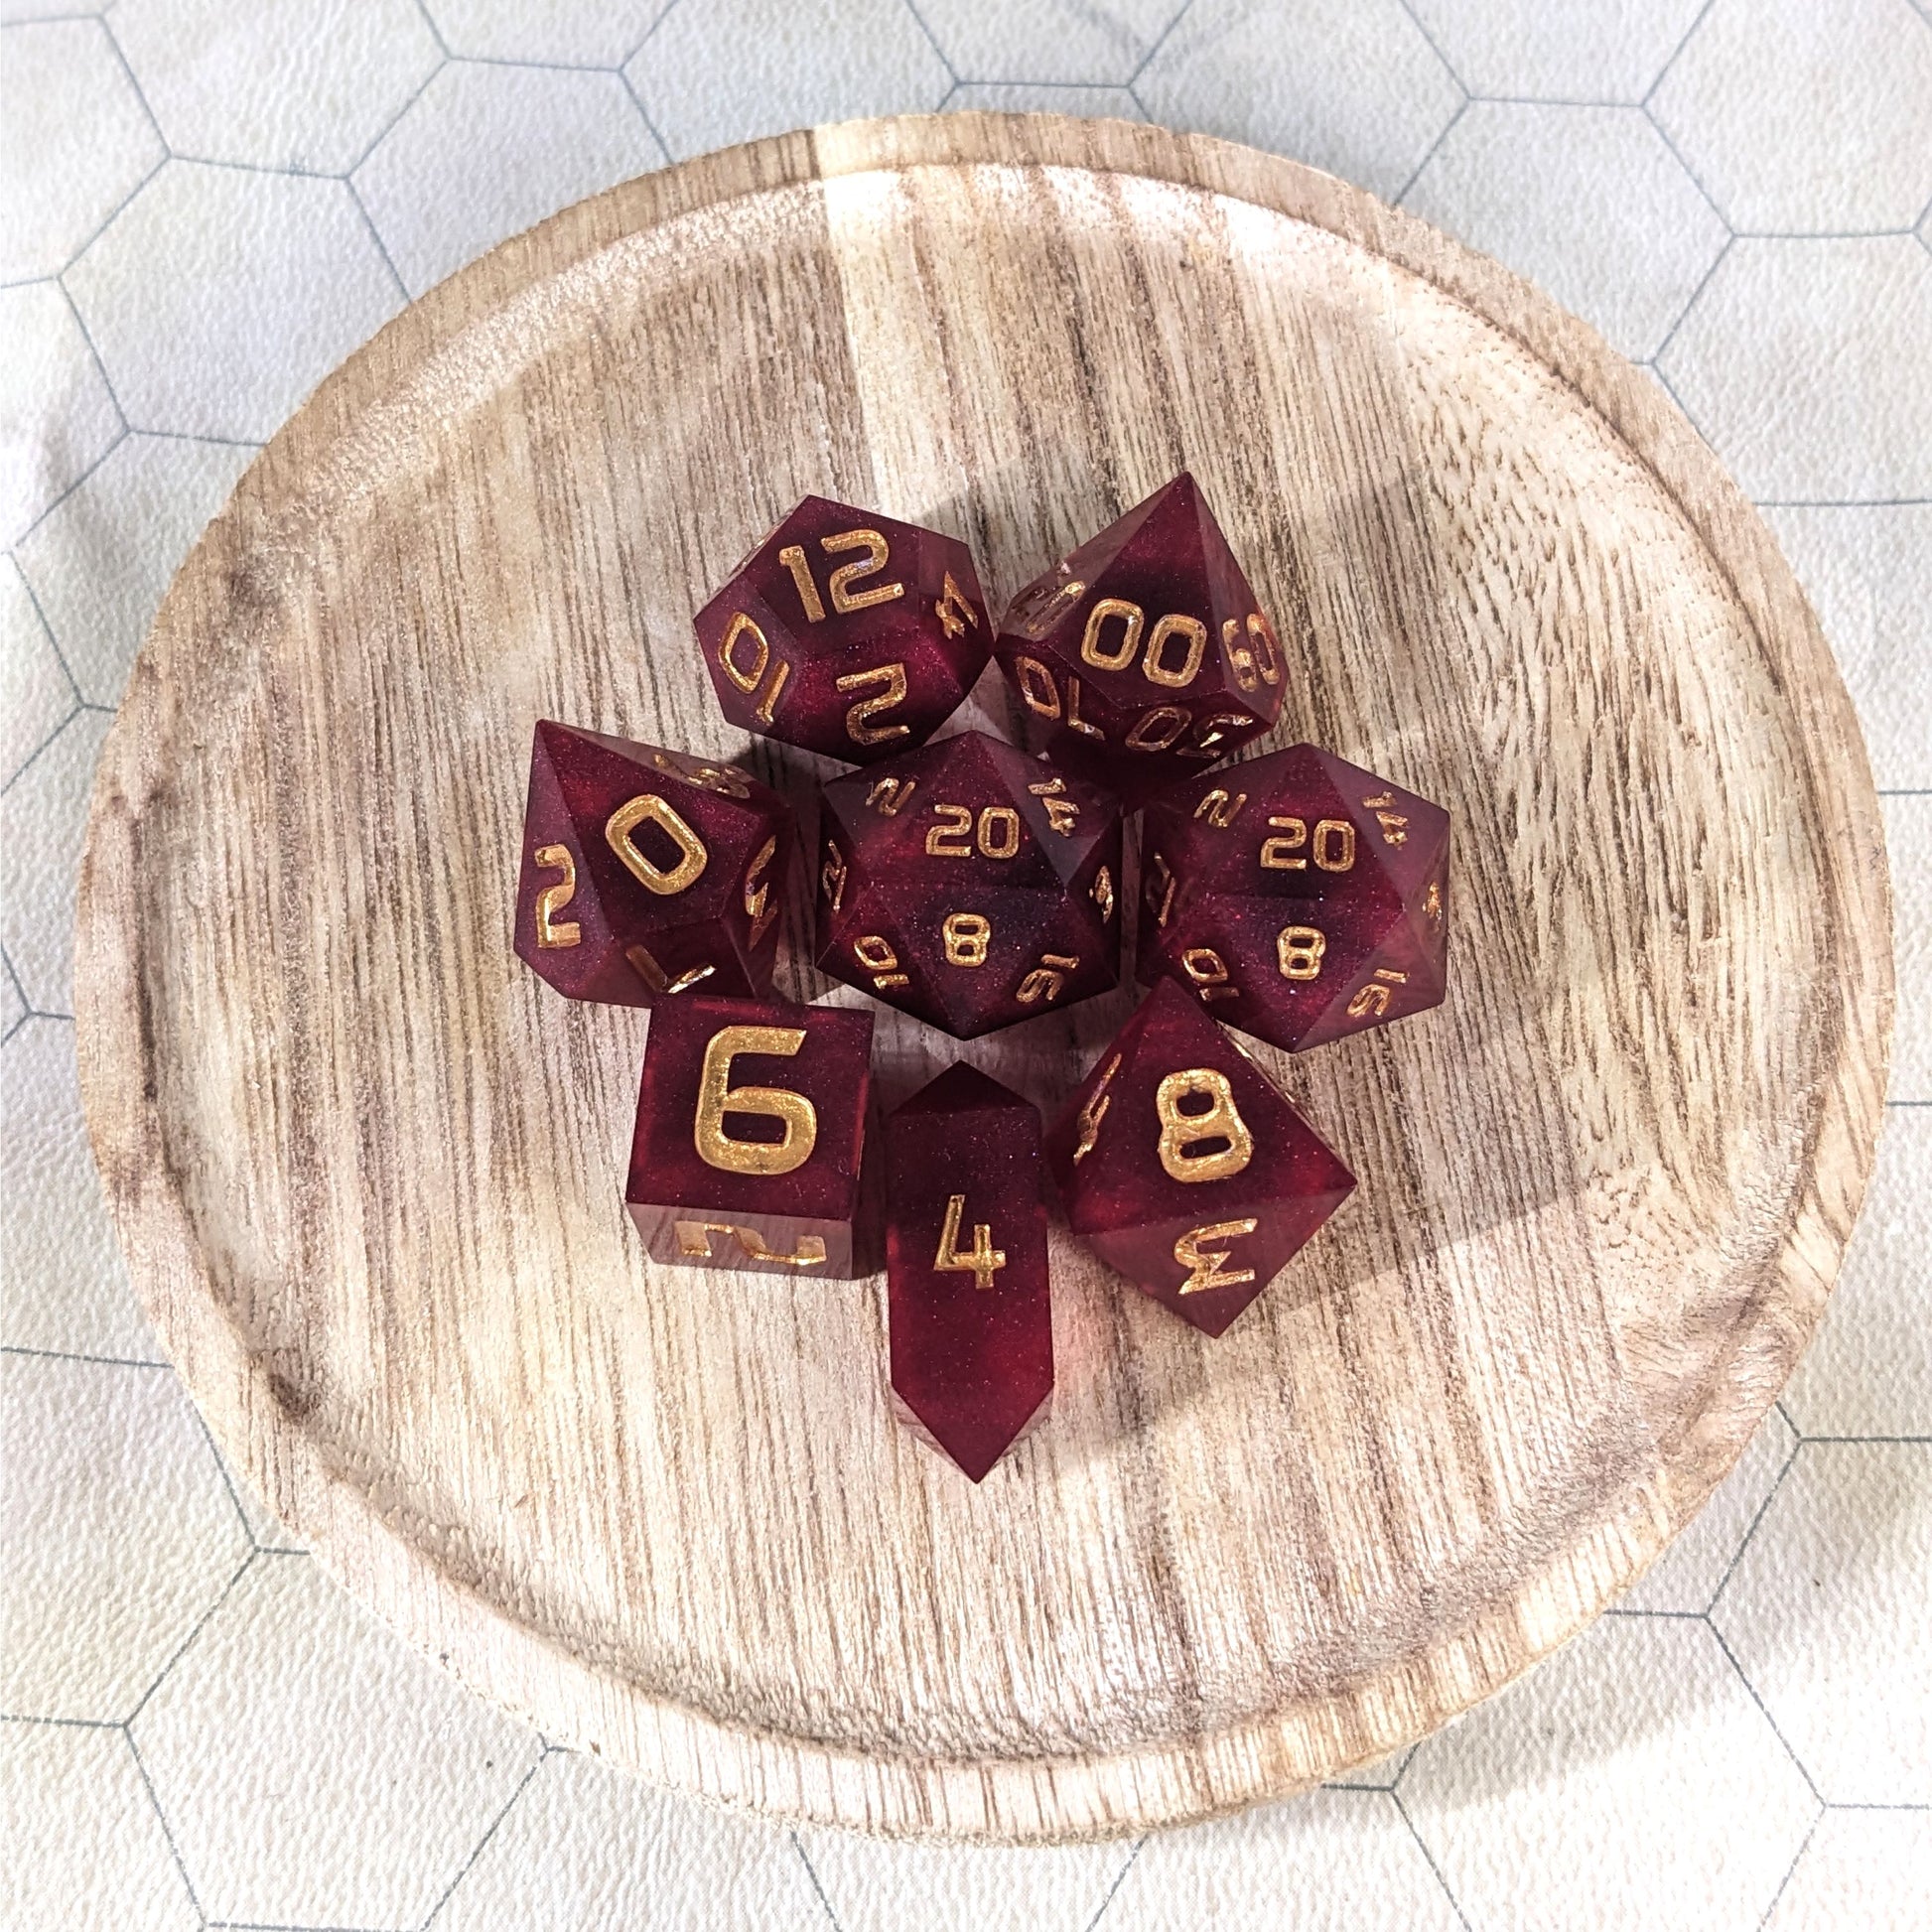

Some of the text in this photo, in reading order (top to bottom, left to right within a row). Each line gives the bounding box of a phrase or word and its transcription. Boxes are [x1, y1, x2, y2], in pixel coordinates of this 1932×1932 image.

[779, 529, 904, 622] 12
[935, 571, 978, 639] 4
[718, 612, 790, 726] 10
[1081, 598, 1207, 688] 00
[836, 662, 910, 745] 2
[865, 777, 915, 816] 2
[1028, 778, 1080, 837] 14
[1193, 789, 1247, 828] 2
[1363, 791, 1408, 850] 14
[605, 793, 708, 896] 0
[925, 804, 1020, 859] 20
[1260, 816, 1355, 873] 20
[534, 844, 582, 949] 2
[854, 935, 909, 990] 10
[942, 912, 991, 967] 8
[1277, 926, 1326, 981] 8
[1181, 948, 1240, 1002] 10
[694, 1026, 817, 1175] 6
[1156, 1067, 1254, 1183] 8
[933, 1194, 1006, 1290] 4
